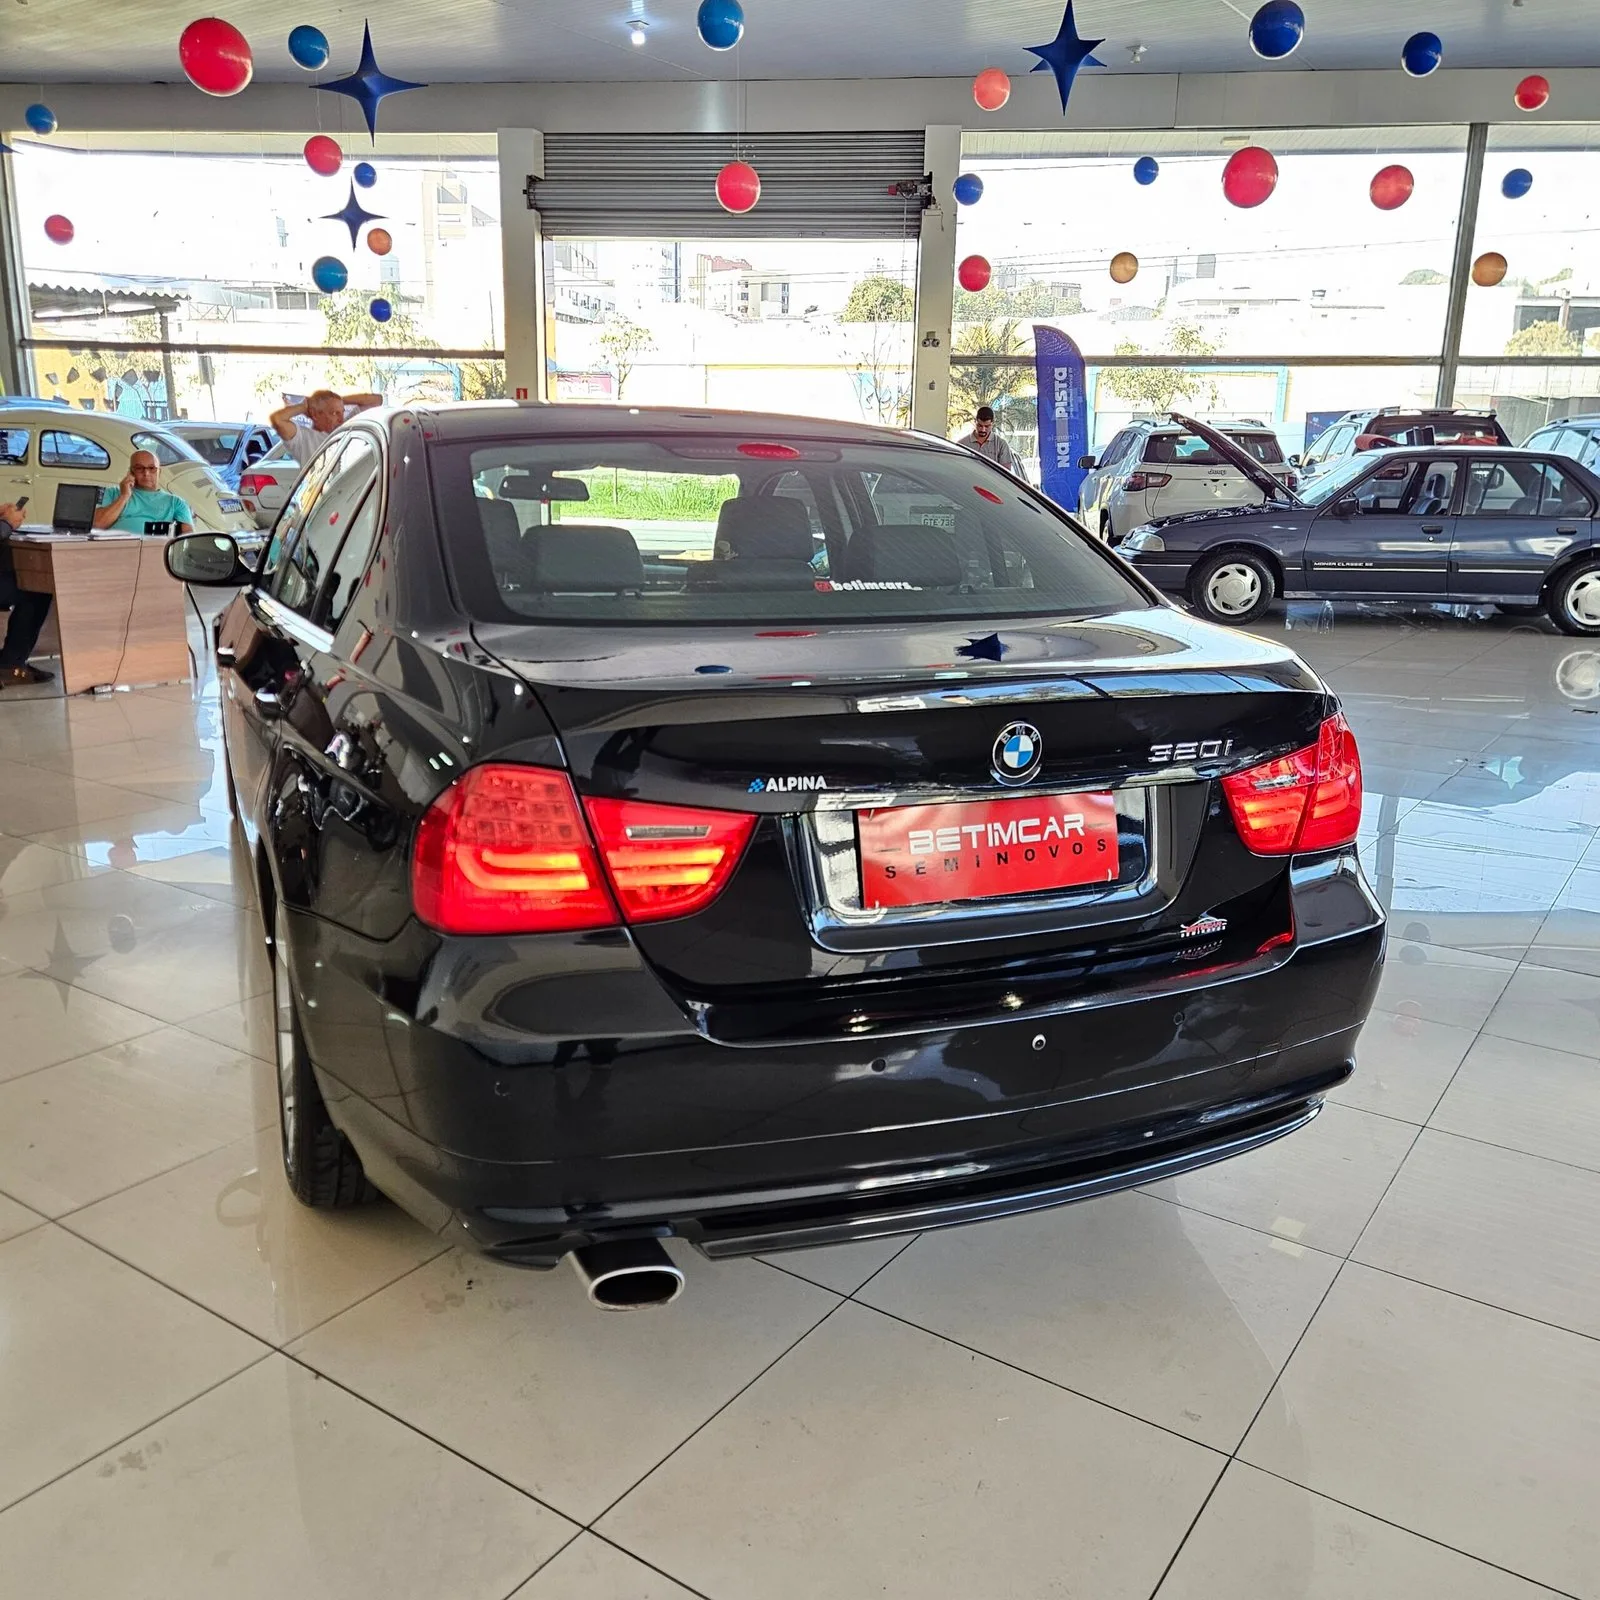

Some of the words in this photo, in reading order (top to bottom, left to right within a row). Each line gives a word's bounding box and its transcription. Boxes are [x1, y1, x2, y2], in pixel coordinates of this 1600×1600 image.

[1147, 739, 1234, 763] 320i
[765, 775, 828, 792] ALPINA
[908, 813, 1085, 855] BETIMCAR
[885, 838, 1107, 879] SEMINOVOS
